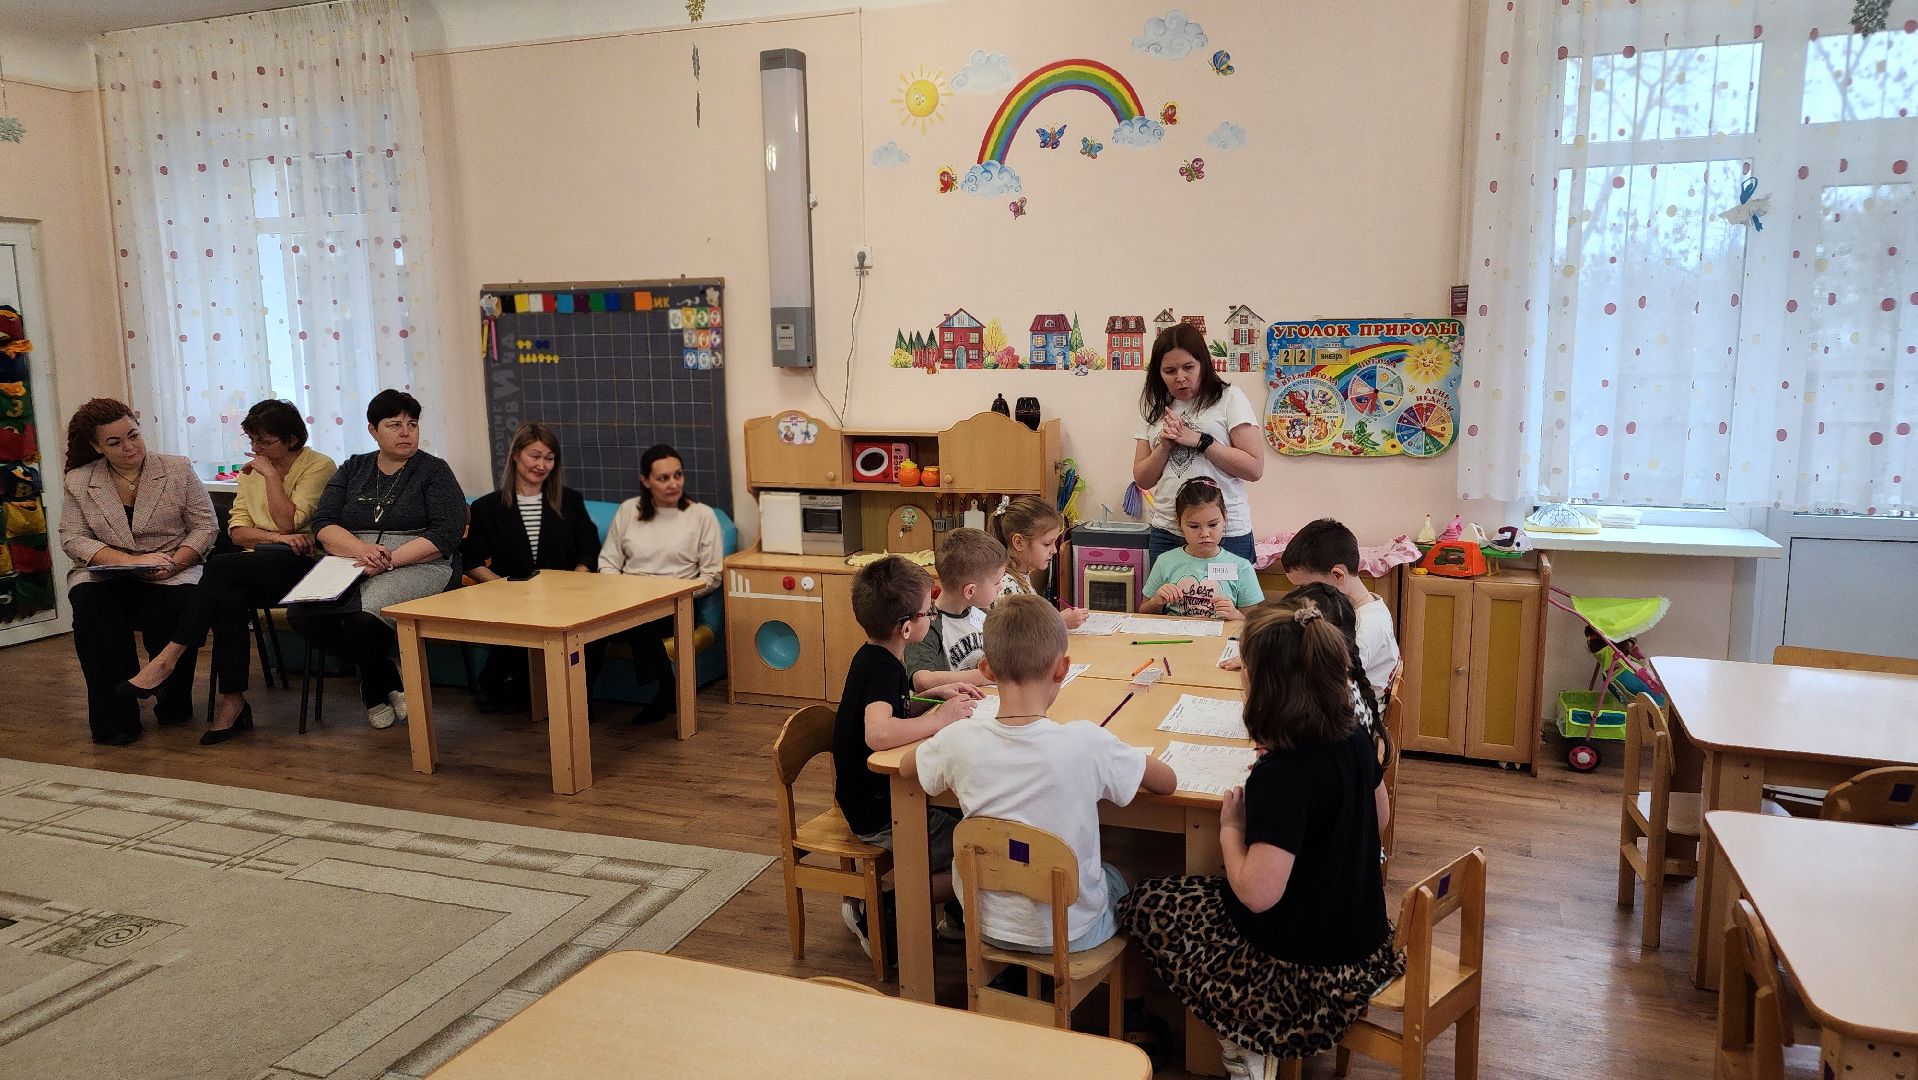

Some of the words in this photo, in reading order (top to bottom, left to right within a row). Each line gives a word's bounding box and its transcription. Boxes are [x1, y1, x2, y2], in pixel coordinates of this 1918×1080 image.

[1273, 324, 1352, 338] УГОЛОК
[1359, 322, 1460, 337] ПРИРОДЫ
[1321, 353, 1343, 361] январь
[1182, 584, 1214, 598] best
